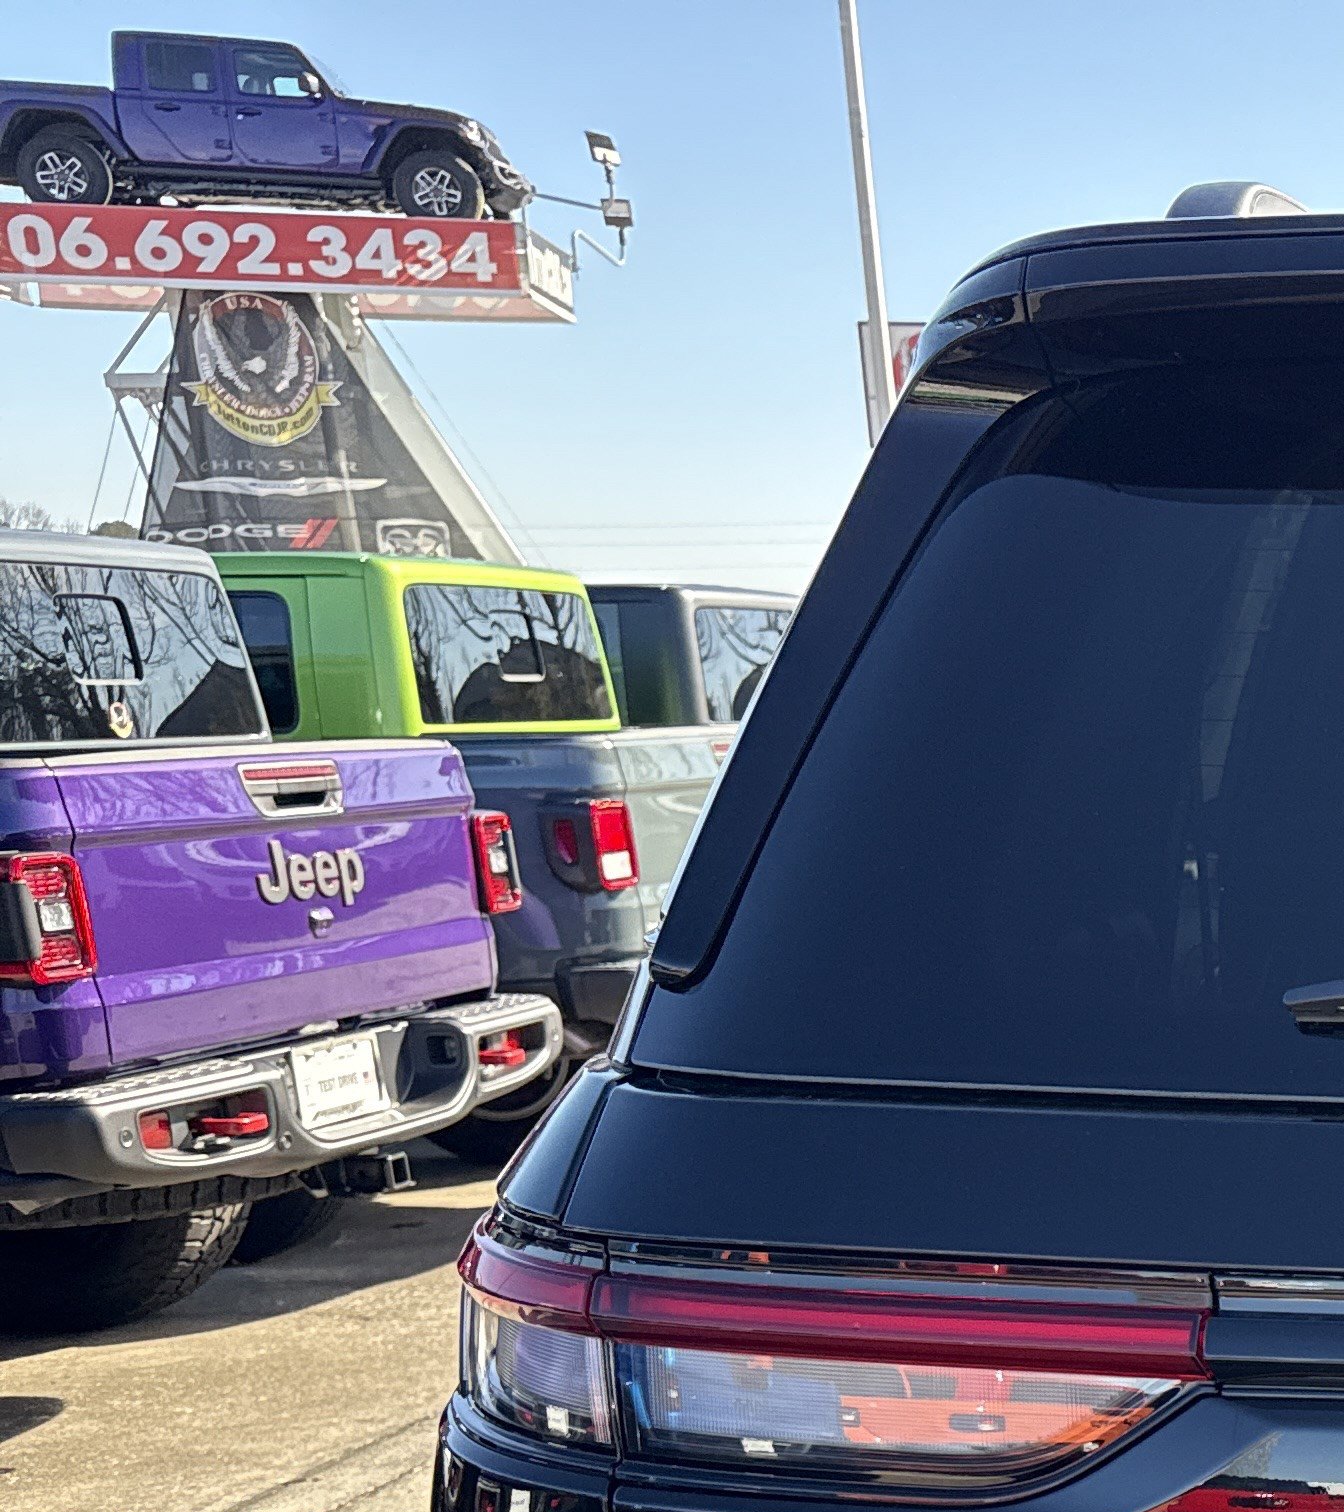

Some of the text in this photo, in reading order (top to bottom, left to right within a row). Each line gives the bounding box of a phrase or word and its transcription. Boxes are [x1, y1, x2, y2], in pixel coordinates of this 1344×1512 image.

[6, 213, 498, 284] 06.692.3434
[224, 296, 263, 310] USA
[144, 523, 309, 545] DODGE
[255, 839, 365, 907] Jeep
